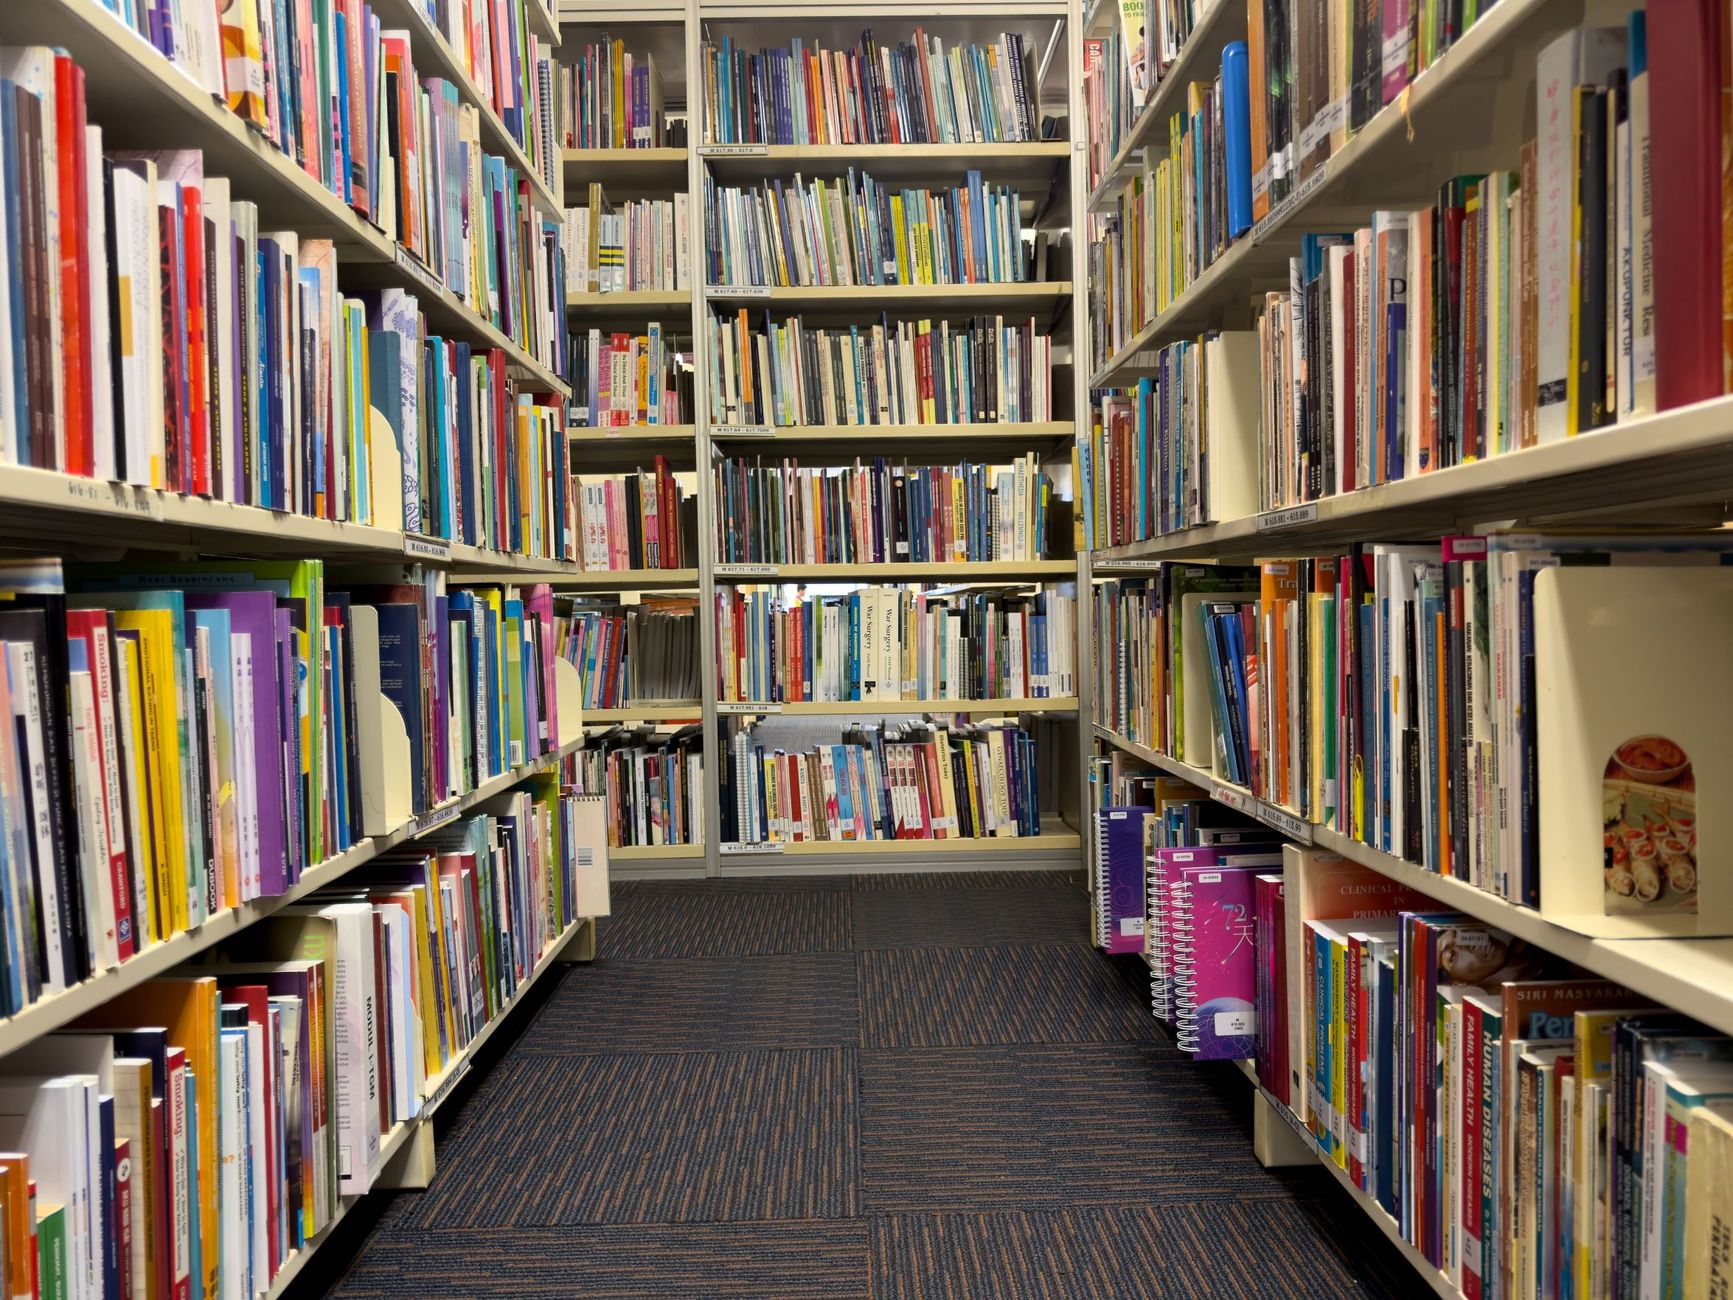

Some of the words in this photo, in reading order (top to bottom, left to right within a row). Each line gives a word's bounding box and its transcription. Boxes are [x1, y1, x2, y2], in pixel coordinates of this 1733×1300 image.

[1641, 228, 1654, 296] Medicine
[864, 620, 872, 650] Surgery
[884, 624, 892, 652] Surgery
[98, 633, 111, 704] Smoking:
[800, 768, 808, 784] WANITA
[996, 746, 1007, 796] GYNAECOLOGY
[802, 796, 811, 812] WANITA
[58, 841, 66, 863] DAN
[117, 862, 126, 909] CRAWFORD
[208, 858, 217, 910] DUBOOK
[1340, 884, 1394, 894] CLINICAL
[1222, 904, 1246, 930] 72
[1517, 991, 1546, 1000] SIRI
[1483, 1030, 1492, 1102] HUMAN
[174, 1074, 184, 1139] Smoking:
[1483, 1105, 1492, 1200] DISEASES
